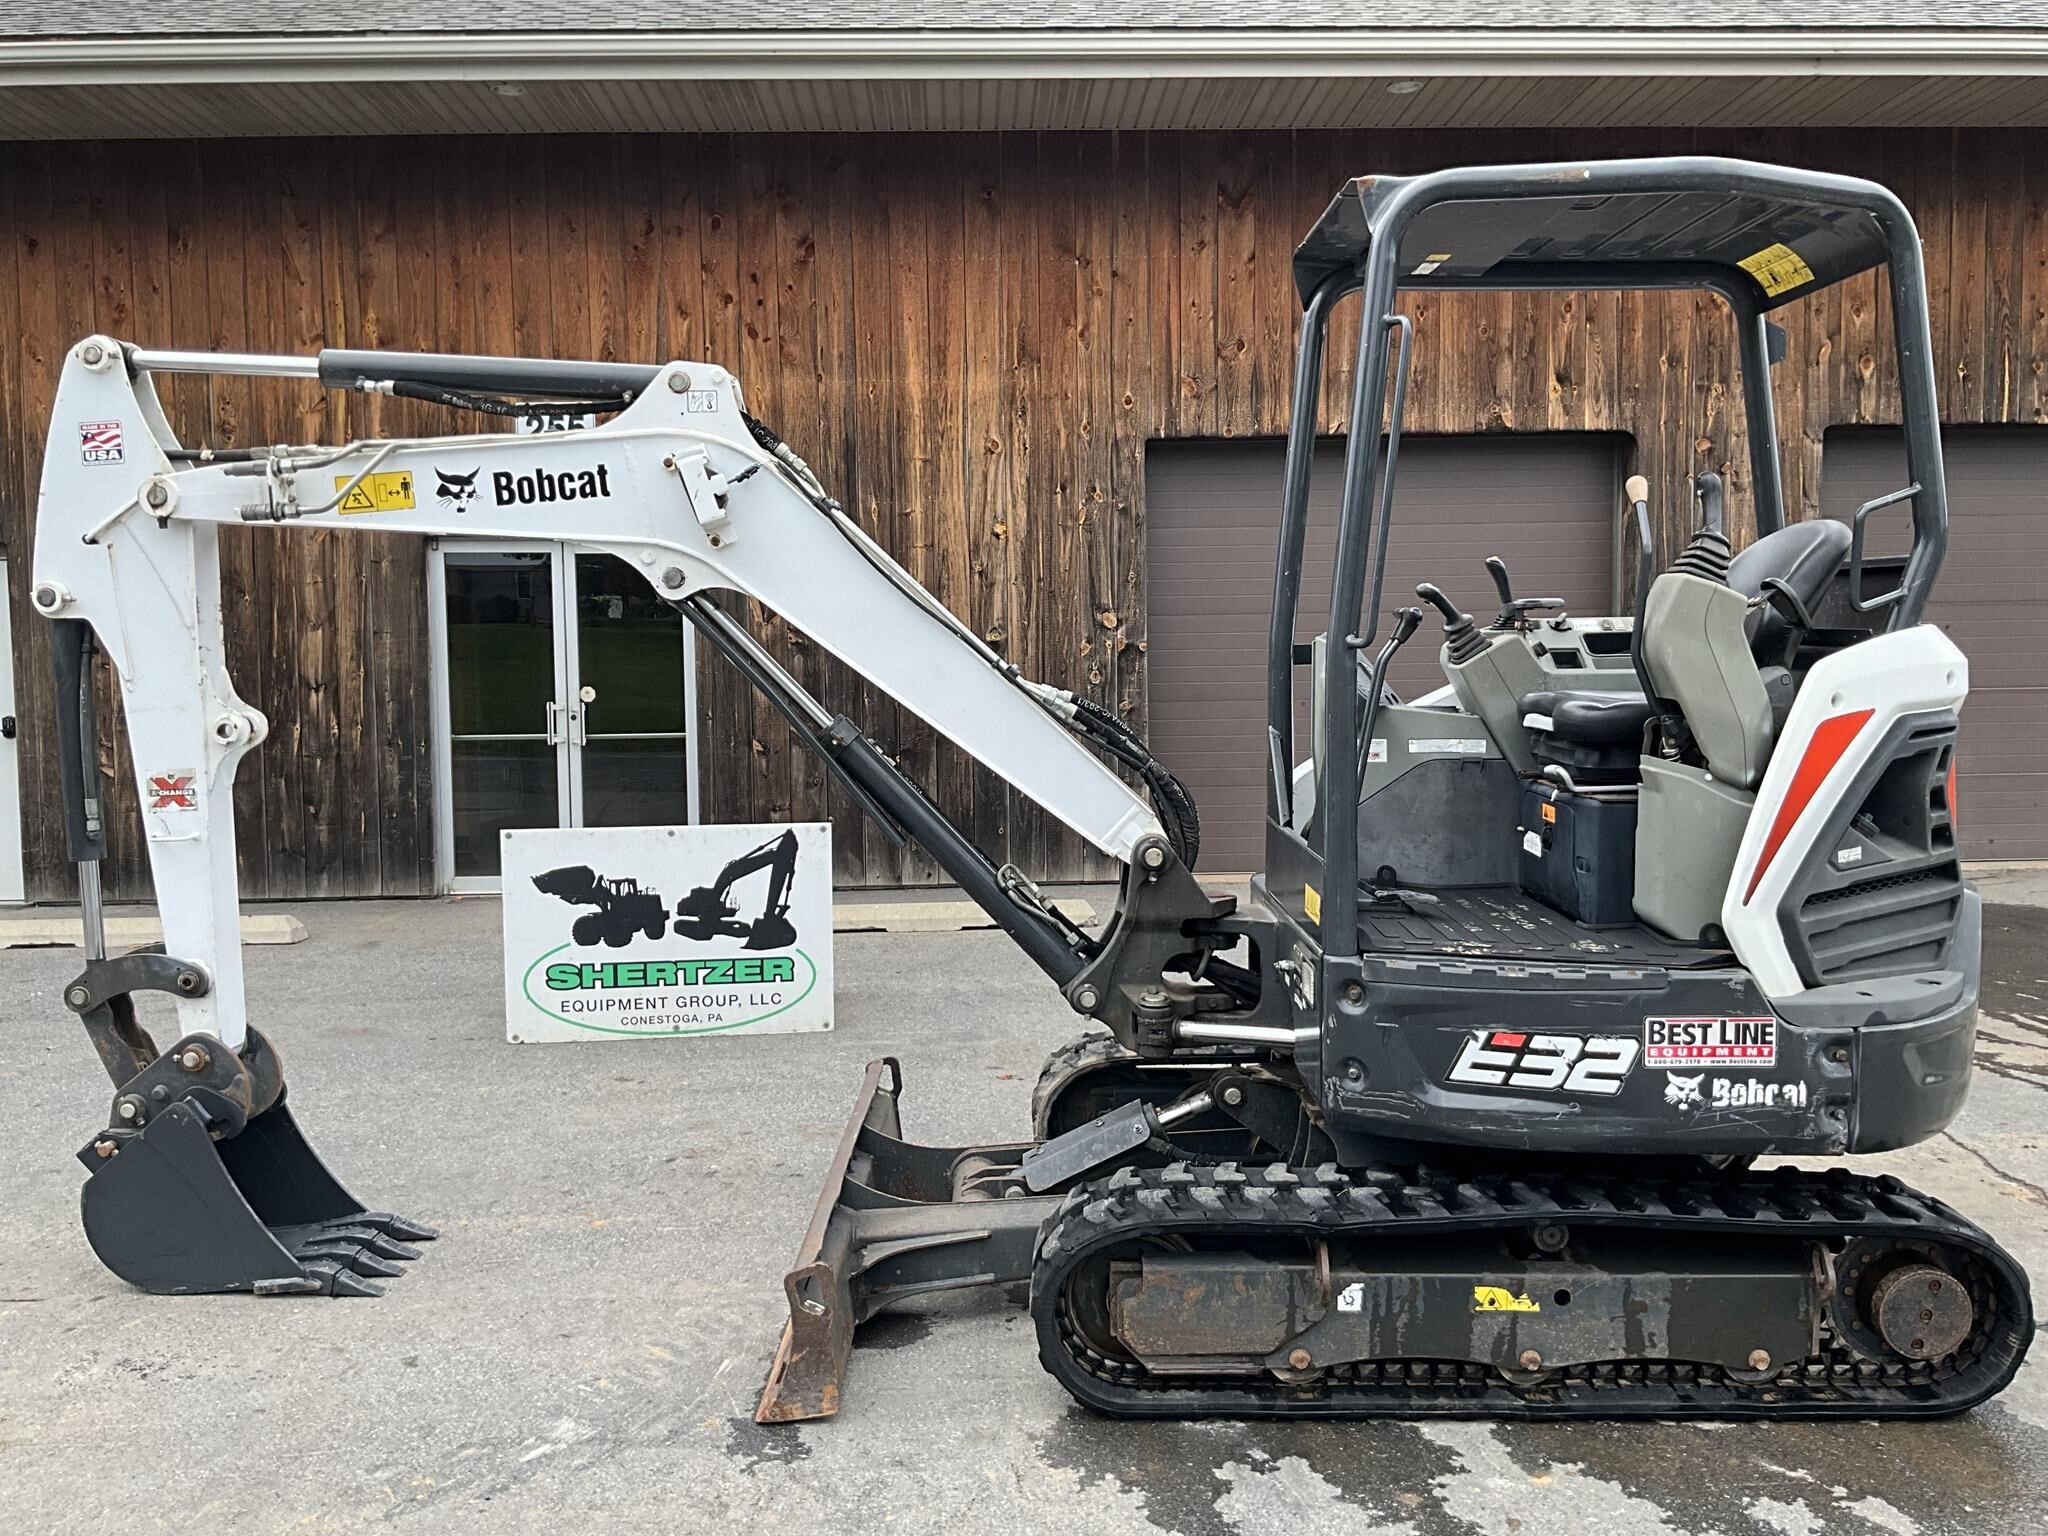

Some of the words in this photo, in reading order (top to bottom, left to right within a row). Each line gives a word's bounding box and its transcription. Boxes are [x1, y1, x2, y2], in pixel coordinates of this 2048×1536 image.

[85, 450, 120, 460] USA
[493, 464, 611, 506] Bobcat
[546, 956, 795, 991] SHERTZER
[561, 996, 668, 1013] EQUIPMENT
[676, 994, 741, 1010] GROUP,
[750, 993, 782, 1006] LLC
[621, 1014, 703, 1027] CONESTOGA,
[708, 1013, 723, 1022] PA
[1648, 1020, 1713, 1045] BEST
[1719, 1020, 1774, 1045] LINE
[1449, 1031, 1639, 1093] E32
[1649, 1047, 1771, 1056] EQUIPMENT
